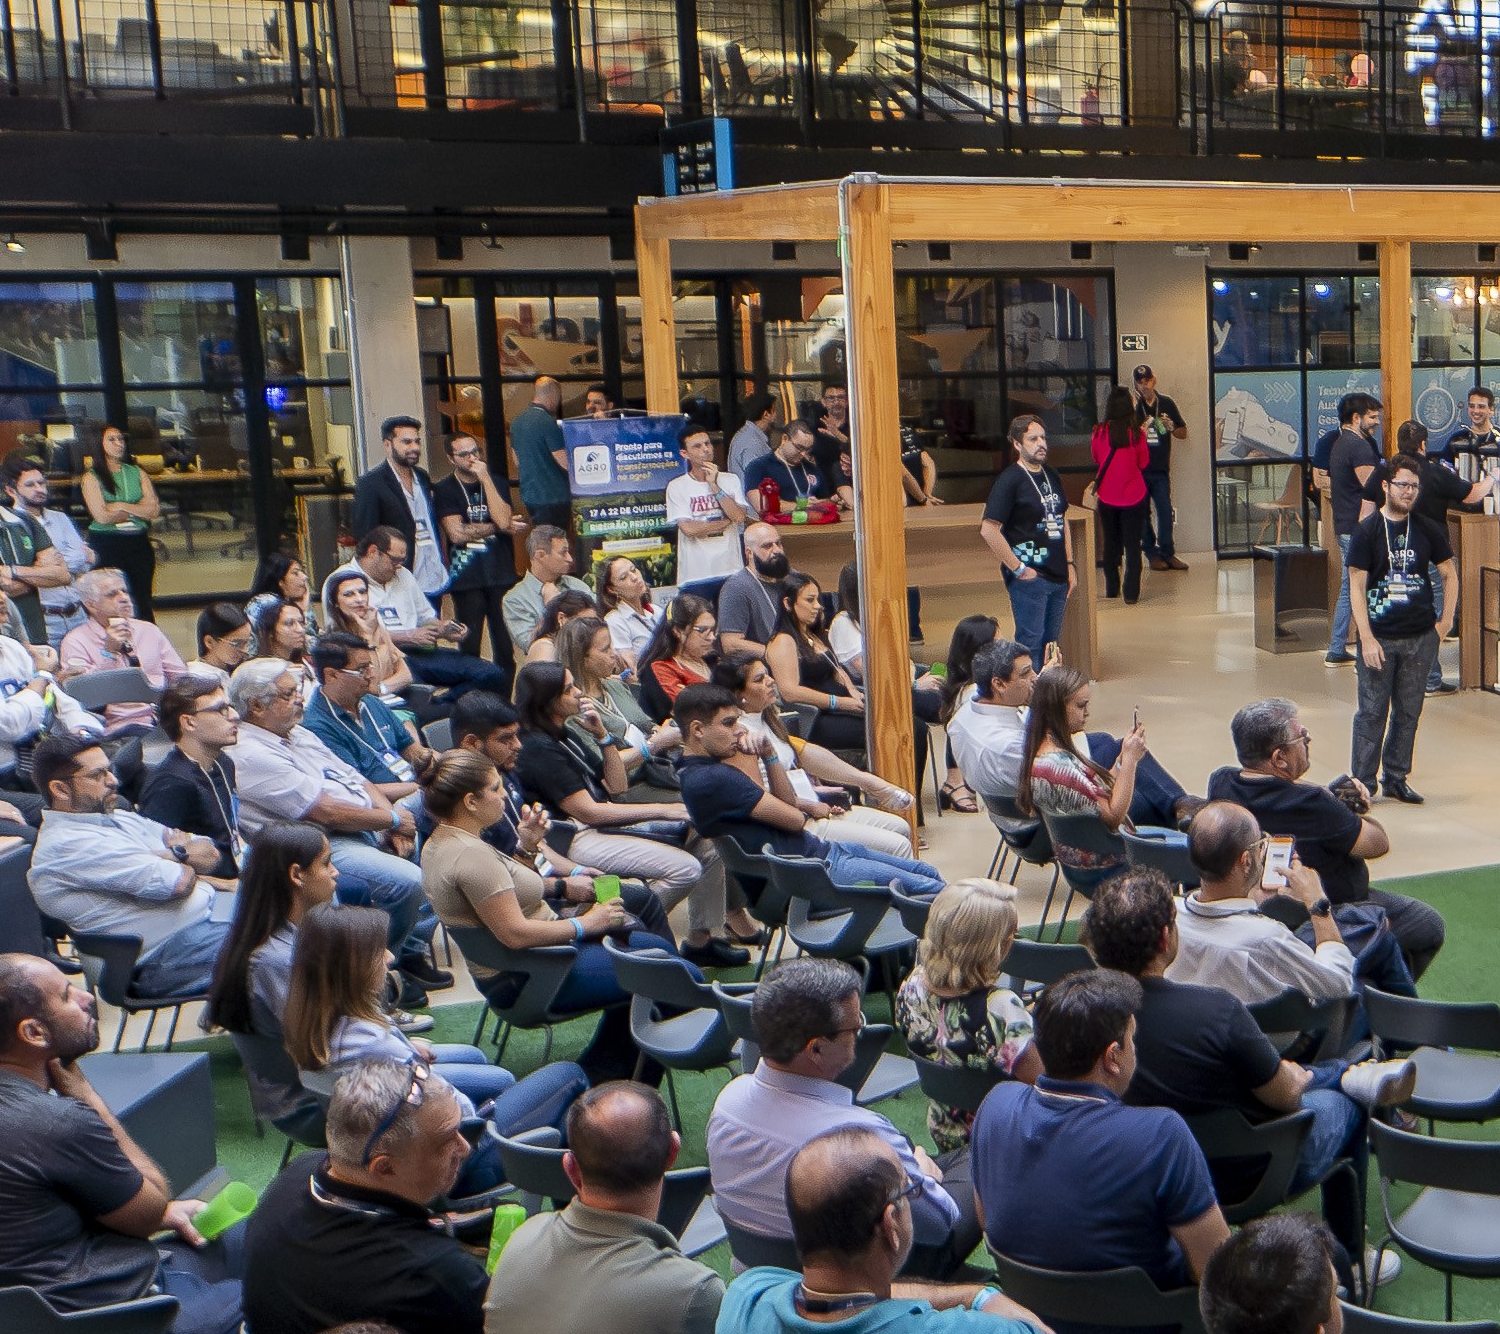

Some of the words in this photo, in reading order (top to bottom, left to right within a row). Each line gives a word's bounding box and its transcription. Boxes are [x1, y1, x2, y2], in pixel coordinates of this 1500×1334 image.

[578, 463, 607, 473] AGRO
[589, 509, 599, 517] 17
[600, 508, 608, 517] A
[619, 506, 631, 515] DE
